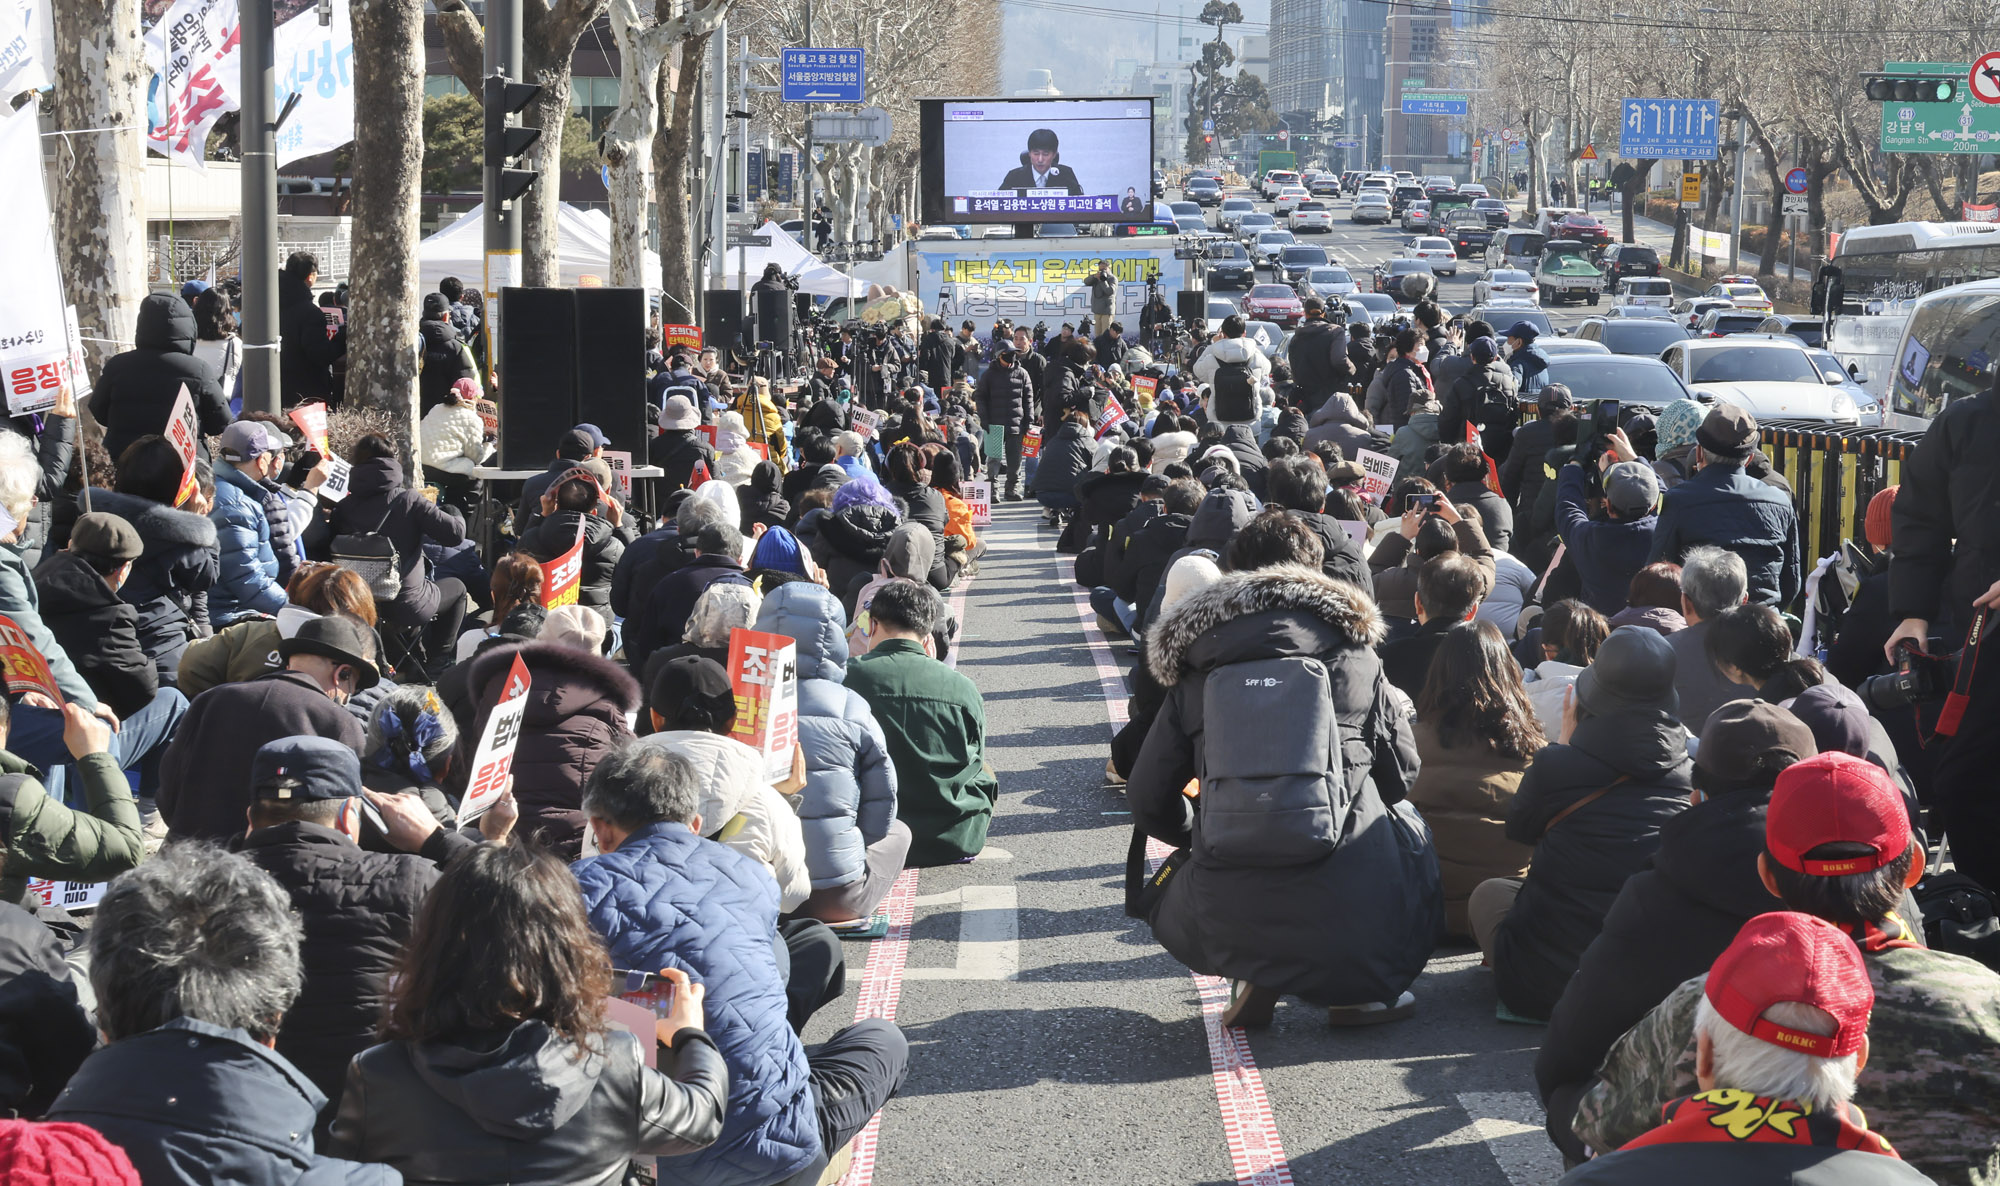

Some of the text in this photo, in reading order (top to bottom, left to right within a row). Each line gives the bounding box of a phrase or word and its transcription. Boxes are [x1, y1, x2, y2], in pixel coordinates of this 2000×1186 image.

[788, 54, 857, 64] 서울고등검찰청
[788, 72, 857, 82] 서울중앙지방검찰청
[1901, 110, 1912, 118] 41
[1961, 116, 1971, 124] 31
[1886, 121, 1925, 134] 강남역
[1885, 135, 1928, 146] Gangnam Stn
[1943, 132, 1952, 140] 90
[1976, 132, 1987, 140] 90
[1666, 147, 1688, 155] 서초역
[1691, 147, 1713, 156] 교차로
[1953, 141, 1979, 151] 200m
[974, 198, 1112, 211] 윤석열·김용현·노상원 등 피고인 출석
[942, 259, 1037, 285] 내란수괴
[936, 285, 1027, 318] 사형을
[669, 327, 699, 338] 조희대를
[668, 336, 701, 349] 탄핵하라!
[1363, 456, 1395, 478] 법비들을
[1969, 614, 1983, 646] Canon
[1245, 678, 1260, 686] SFF
[1823, 862, 1856, 872] ROKMC
[1155, 865, 1172, 886] Nikon
[1775, 1031, 1817, 1049] ROKMC
